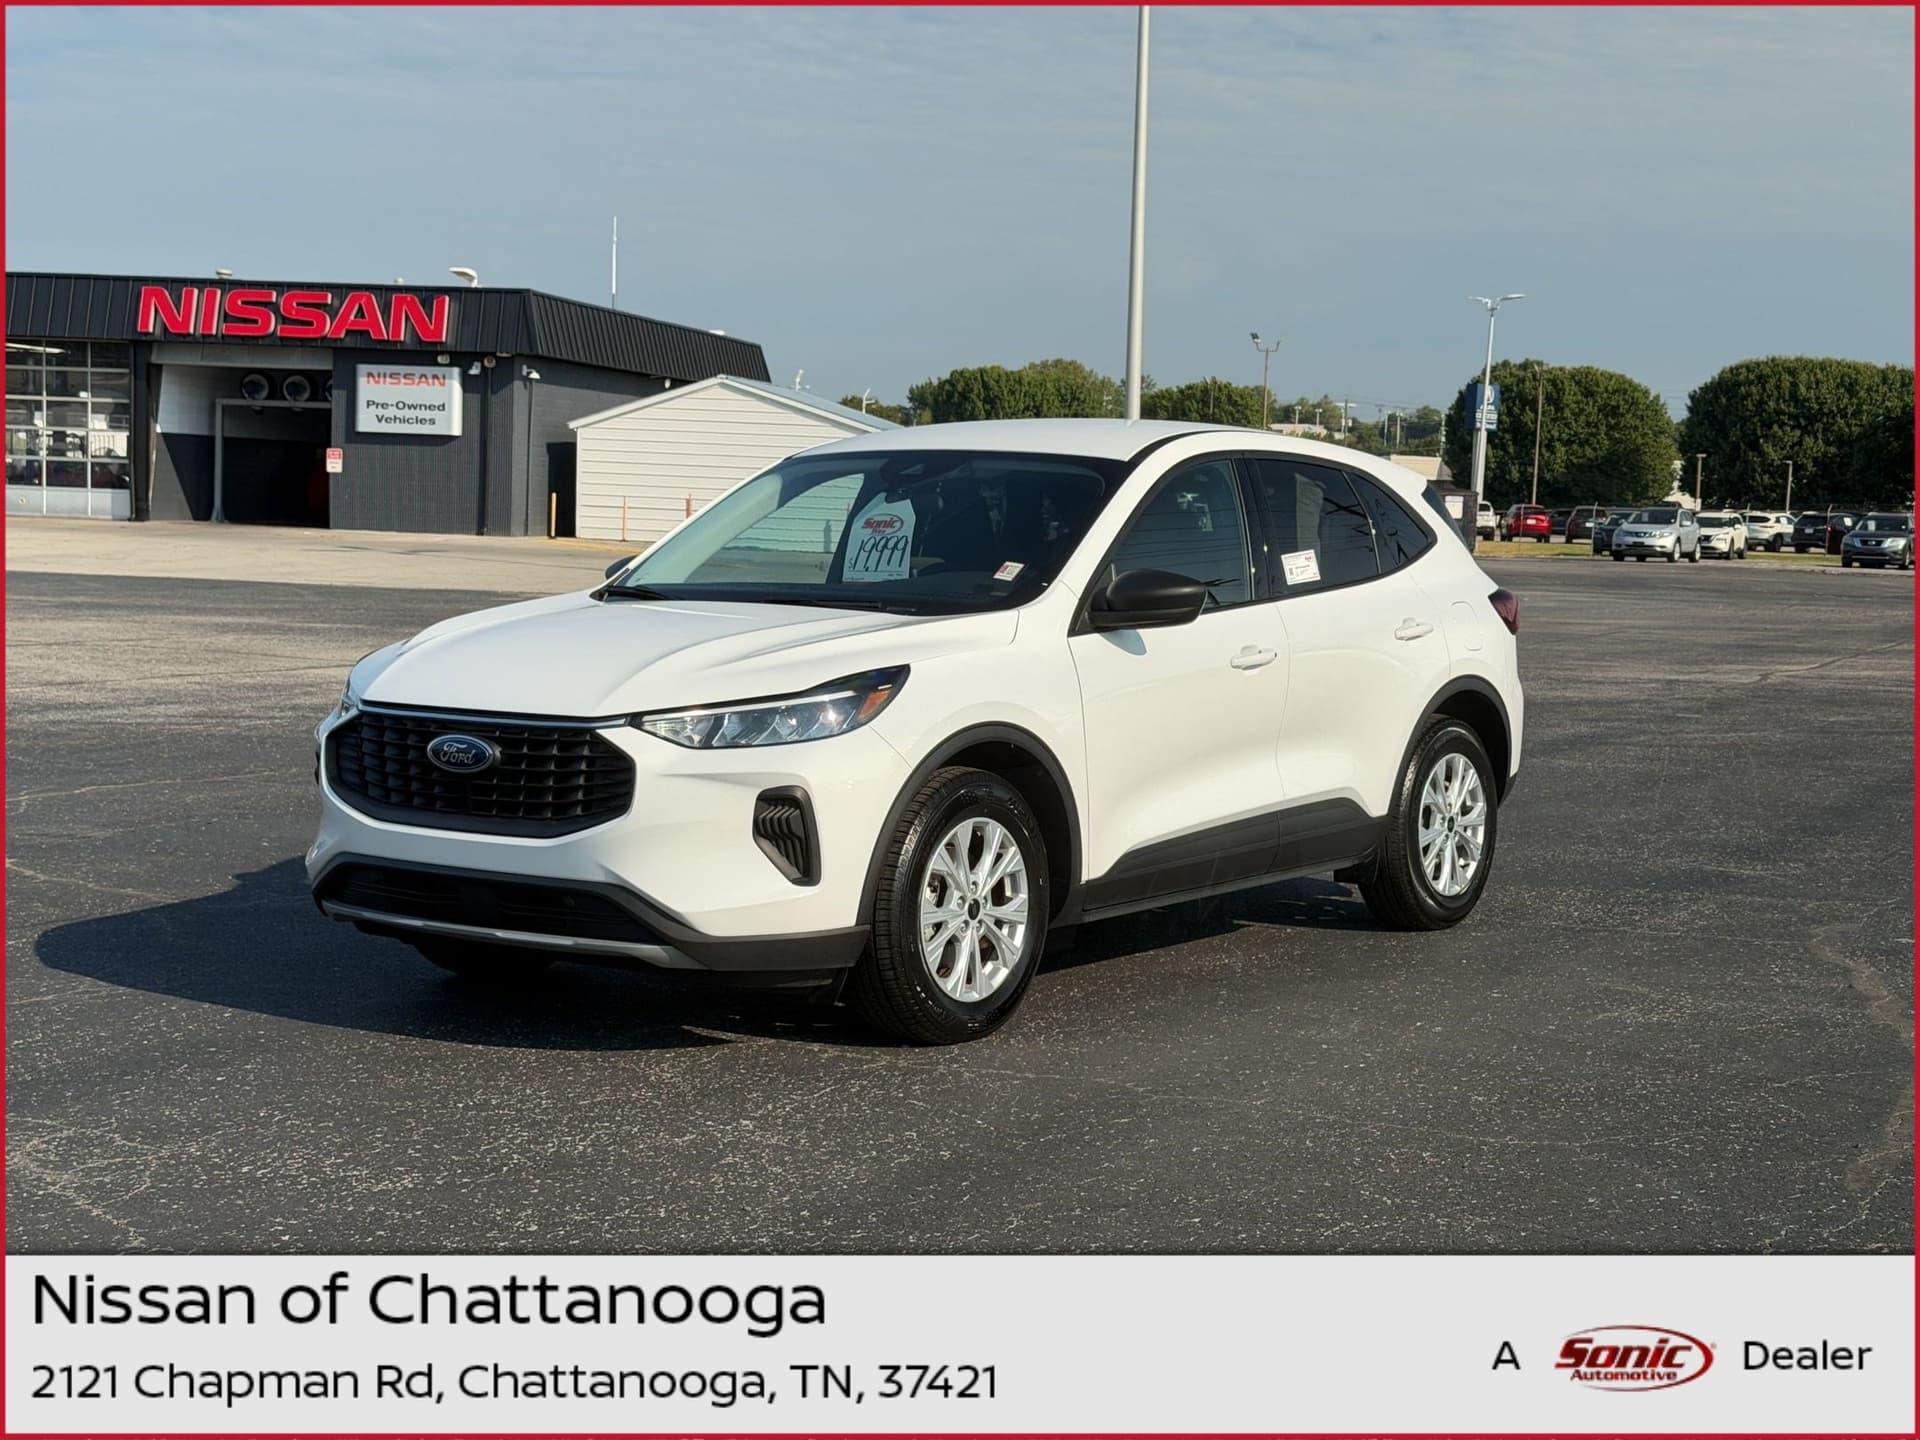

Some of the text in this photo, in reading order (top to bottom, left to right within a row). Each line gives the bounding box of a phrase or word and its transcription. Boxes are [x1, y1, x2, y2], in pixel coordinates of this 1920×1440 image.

[138, 286, 448, 342] NISSAN
[366, 371, 446, 387] NISSAN
[366, 400, 446, 412] Pre-Owned
[375, 414, 436, 426] Vehicles
[440, 741, 477, 764] Ford
